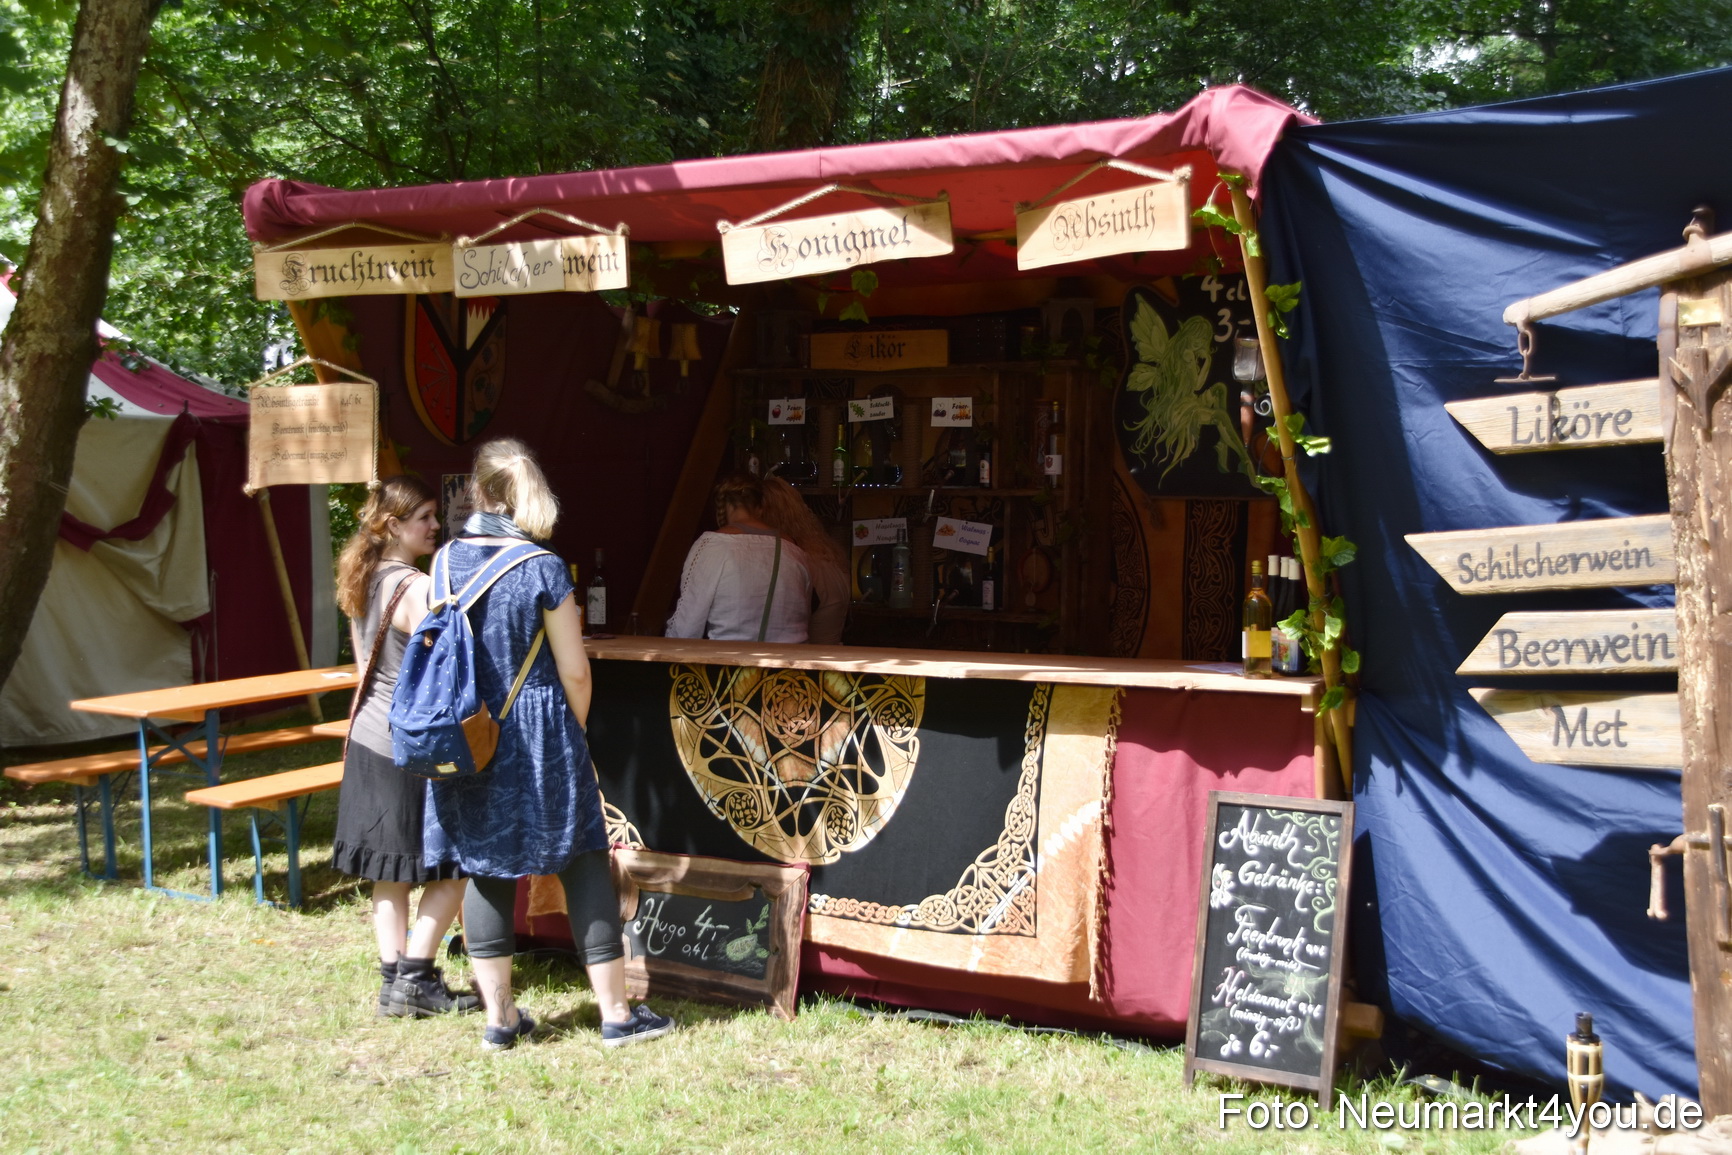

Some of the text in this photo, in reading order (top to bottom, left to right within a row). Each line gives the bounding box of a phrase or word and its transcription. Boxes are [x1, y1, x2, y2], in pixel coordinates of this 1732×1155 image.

[756, 214, 913, 274] Honigmet
[1050, 191, 1156, 255] Absinth
[279, 250, 437, 295] Fruchtwein
[460, 249, 553, 289] Schilcher
[1200, 275, 1247, 303] 4 cl
[844, 333, 906, 367] Likör
[1507, 401, 1633, 446] Liköre
[1457, 540, 1654, 585] Schilcherwein
[1492, 622, 1674, 670] Beerwein
[1552, 706, 1628, 749] Met
[632, 897, 686, 955] Hugo
[1227, 905, 1321, 970] Feentrunk
[682, 943, 709, 961] 0,4l
[1212, 966, 1296, 1013] Heldenmut
[1220, 1033, 1242, 1057] je
